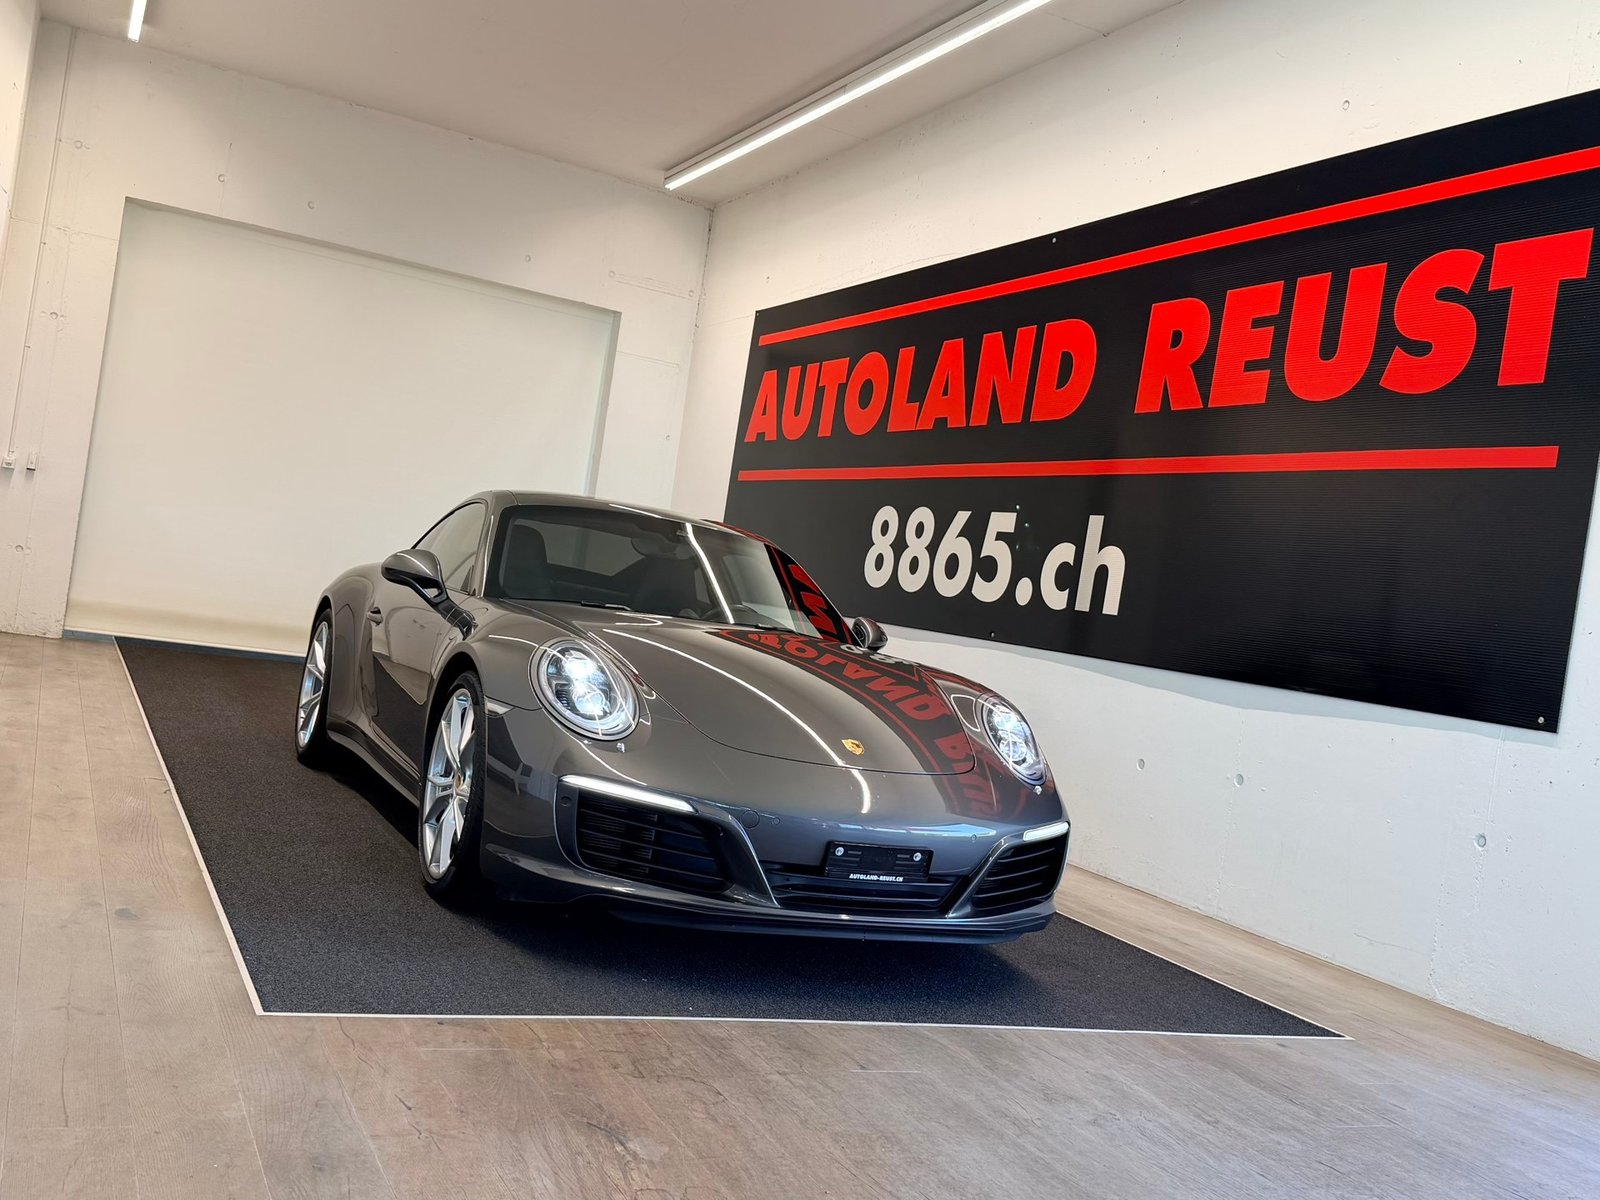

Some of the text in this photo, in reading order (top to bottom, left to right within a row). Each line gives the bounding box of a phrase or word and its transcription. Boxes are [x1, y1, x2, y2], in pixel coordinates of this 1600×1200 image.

[744, 228, 1595, 443] AUTOLAND REUST
[864, 505, 1126, 616] 8865.ch
